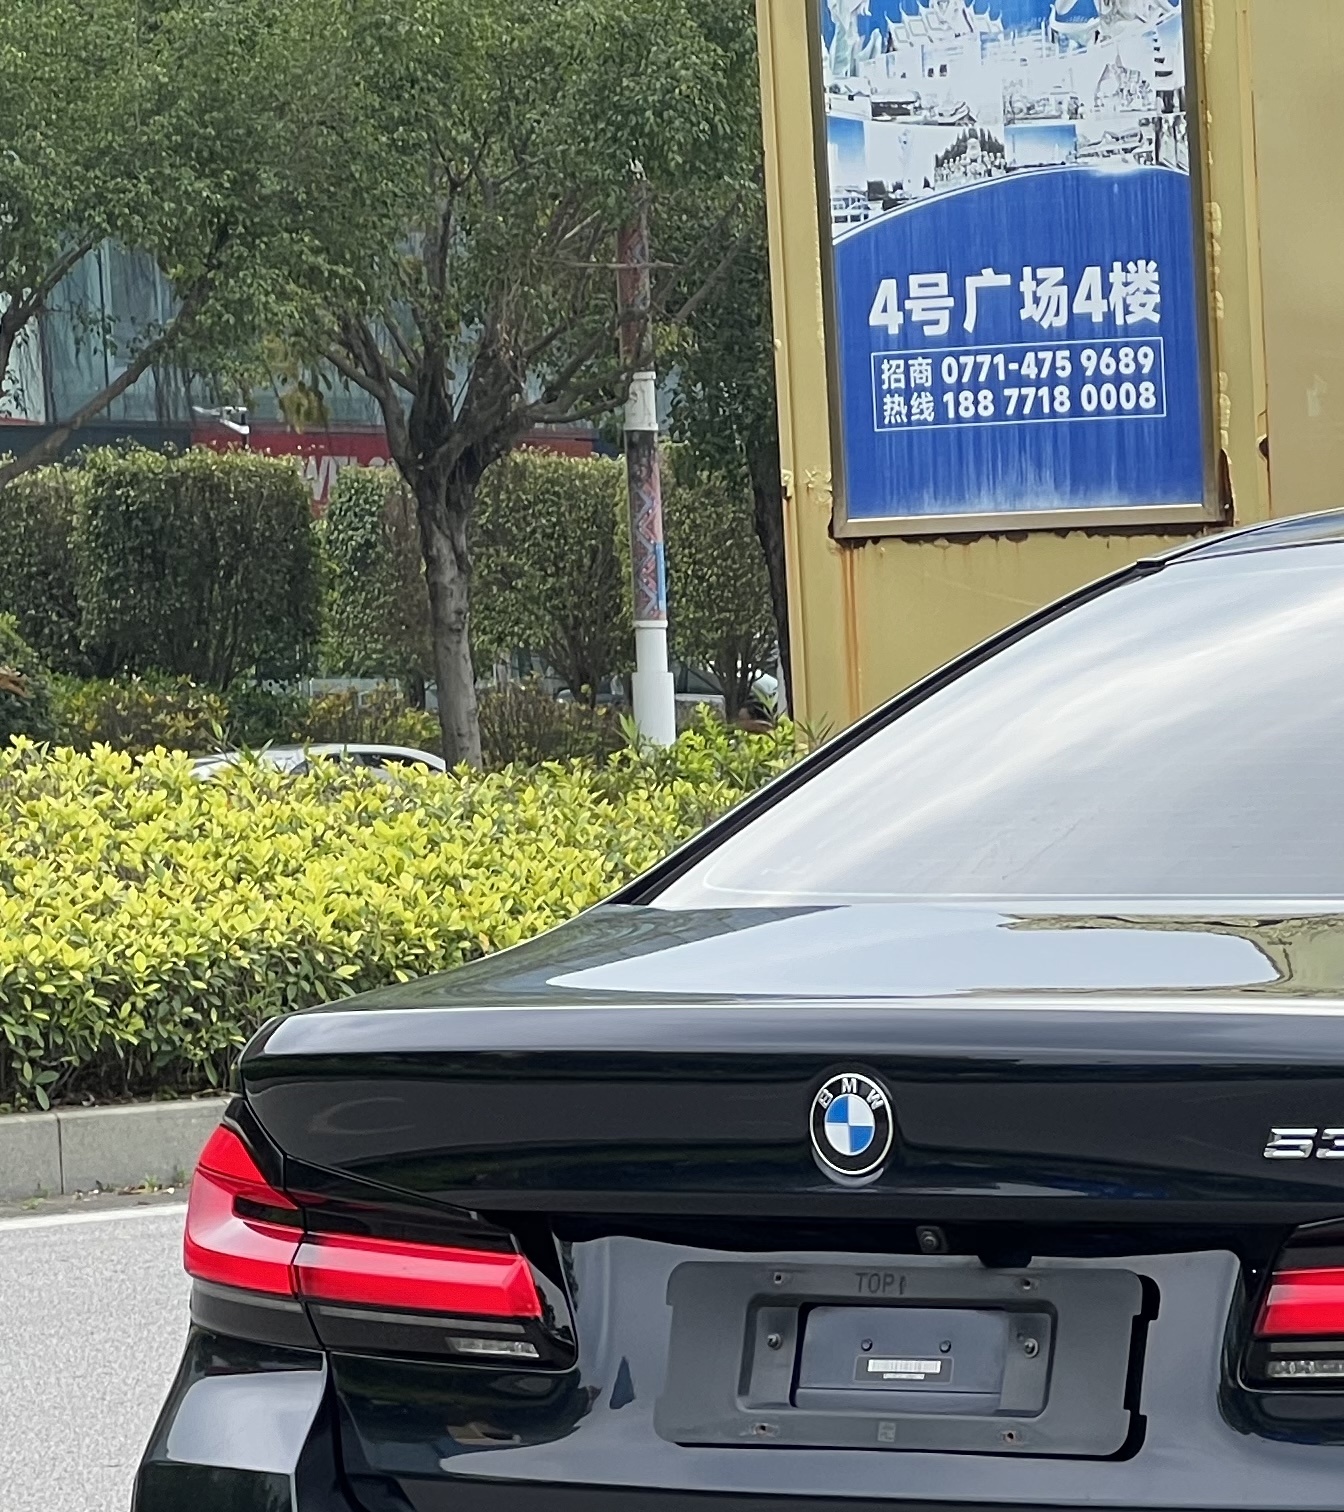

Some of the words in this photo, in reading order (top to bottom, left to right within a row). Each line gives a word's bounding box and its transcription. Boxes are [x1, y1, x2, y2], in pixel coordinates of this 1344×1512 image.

[867, 258, 1162, 338] 4号广场4楼
[880, 358, 932, 390] 招商
[941, 349, 1073, 384] 0771-475
[1080, 345, 1155, 378] 9689
[883, 391, 936, 425] 热线
[943, 389, 994, 419] 188
[1003, 386, 1071, 416] 7718
[1080, 381, 1157, 411] 0008
[818, 1077, 884, 1110] BMW
[855, 1272, 895, 1294] TOP
